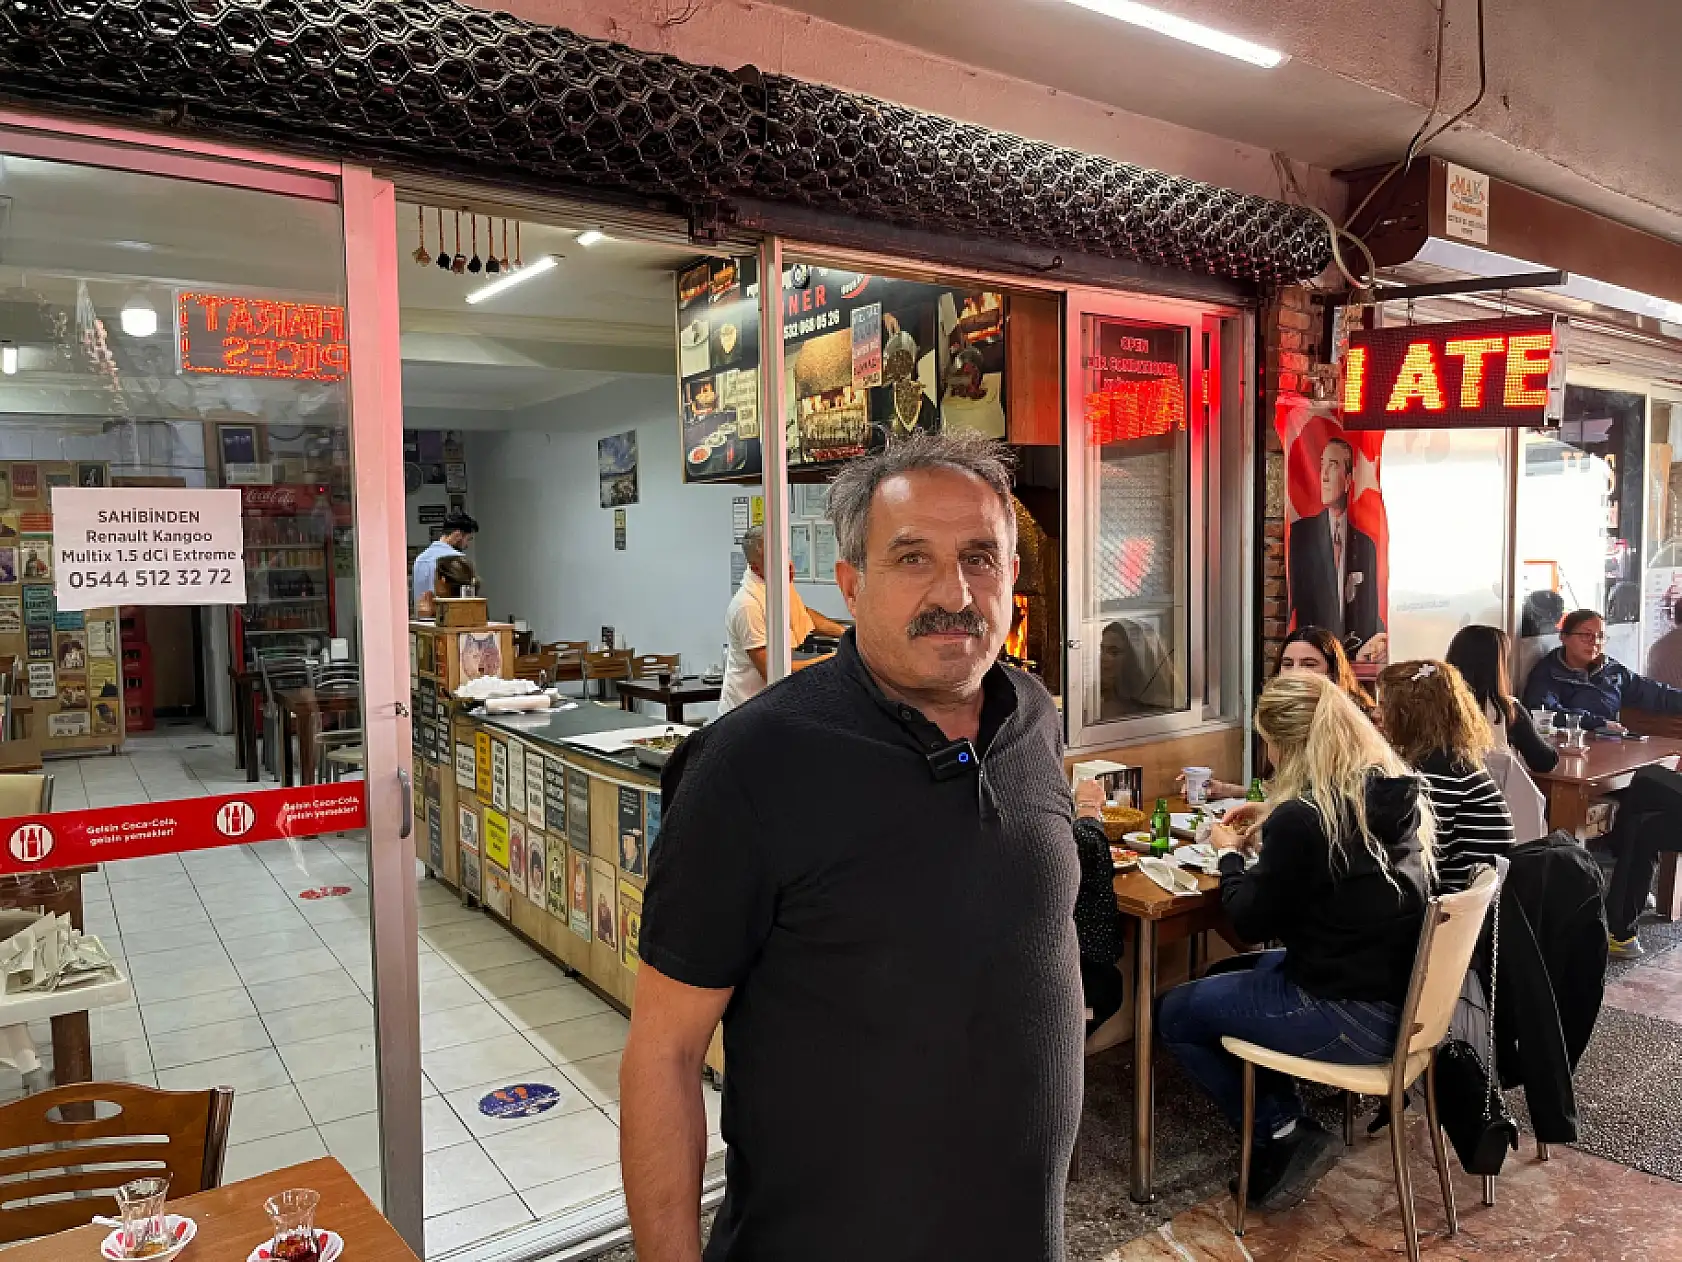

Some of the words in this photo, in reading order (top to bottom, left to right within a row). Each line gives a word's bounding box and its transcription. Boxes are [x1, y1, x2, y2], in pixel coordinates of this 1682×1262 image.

[788, 284, 827, 317] NER
[98, 508, 200, 523] SAHİBİNDEN
[86, 529, 148, 543] Renault
[153, 529, 213, 544] Kangoo
[62, 550, 112, 563] Multix
[117, 549, 137, 562] 1.5
[143, 549, 168, 562] dCi
[173, 548, 237, 562] Extreme
[69, 570, 129, 589] 0544
[135, 569, 171, 587] 512
[177, 569, 202, 586] 32
[207, 568, 232, 585] 72
[86, 824, 119, 834] Gelsin
[90, 835, 122, 847] gelsin
